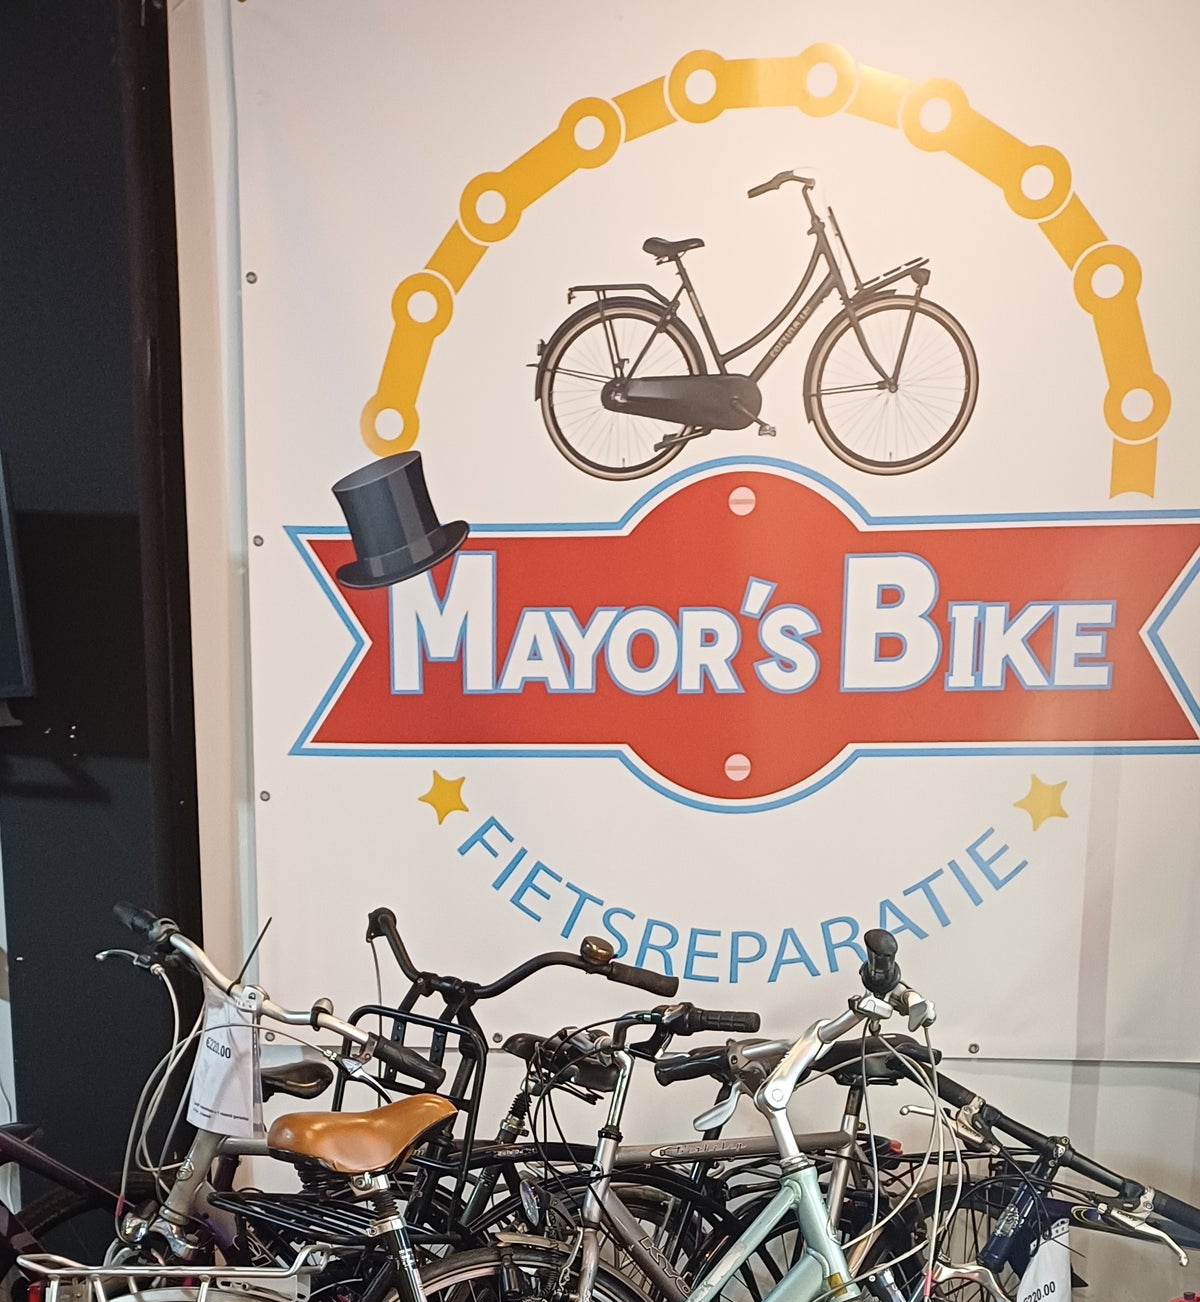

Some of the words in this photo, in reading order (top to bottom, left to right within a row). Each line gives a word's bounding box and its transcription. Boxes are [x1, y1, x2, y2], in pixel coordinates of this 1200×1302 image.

[389, 551, 821, 694] MAYOR'S
[840, 553, 1117, 691] BIKE
[458, 816, 1029, 983] FIETSREPARATIE
